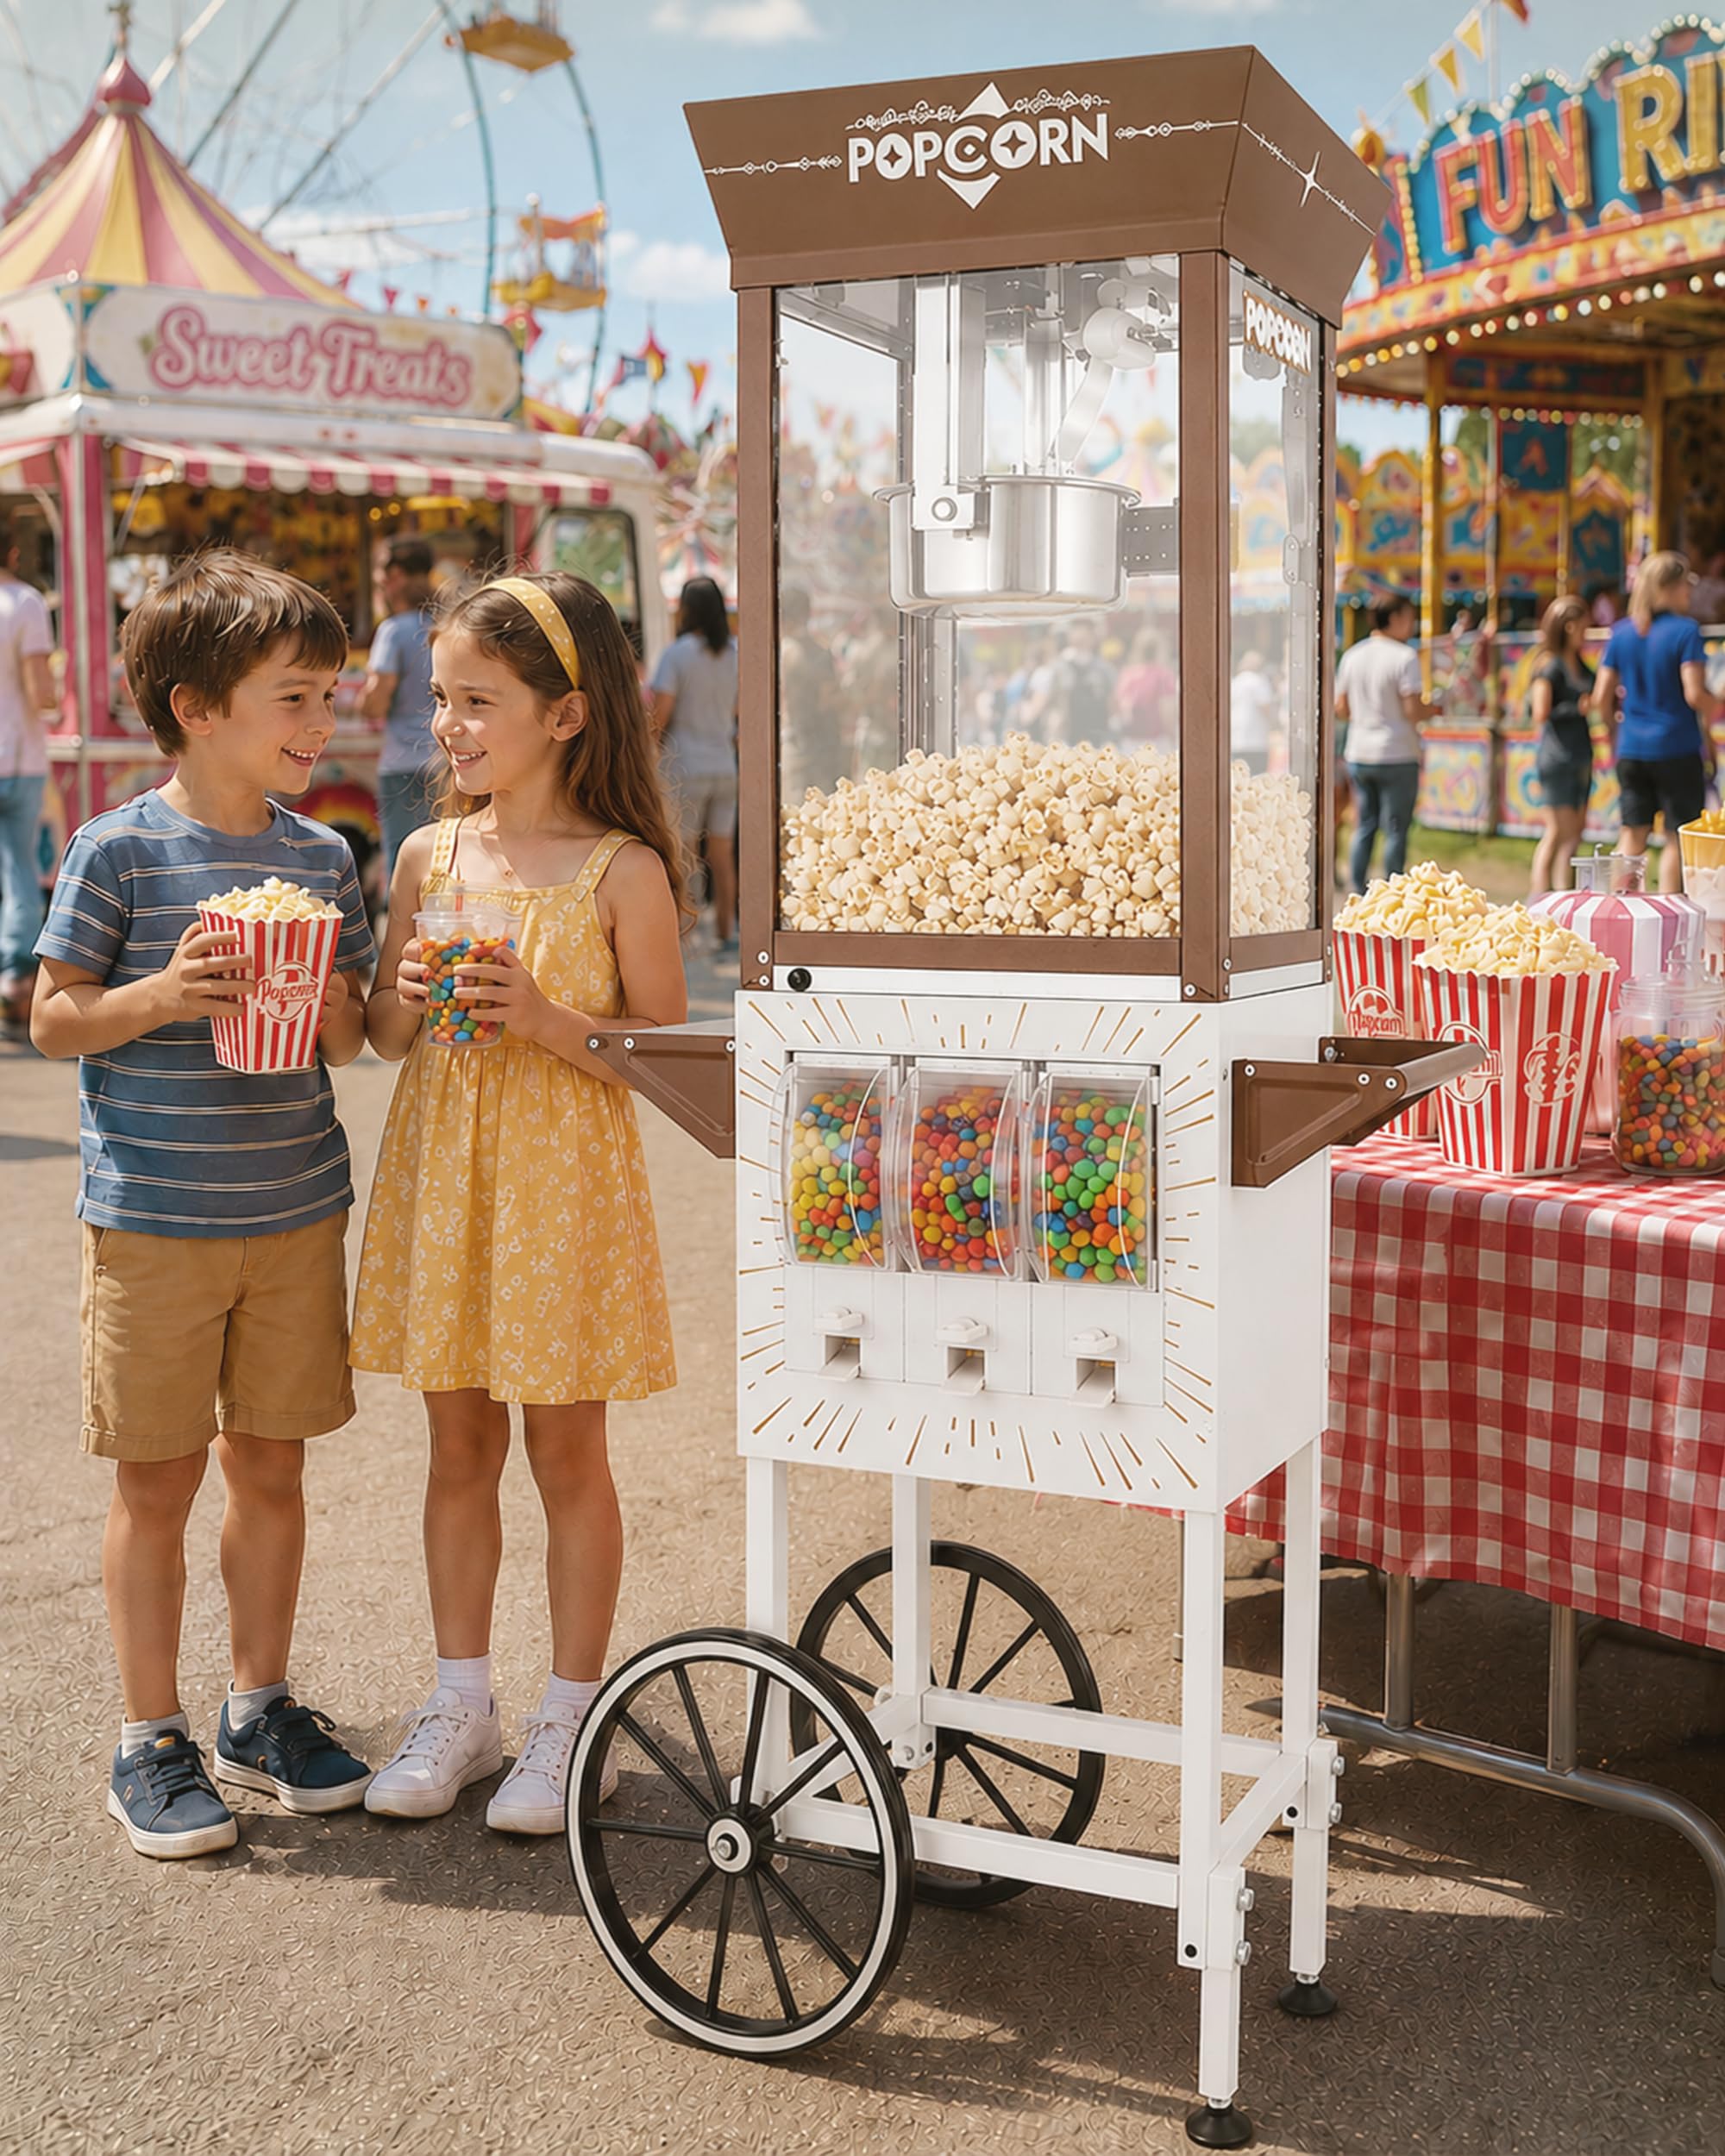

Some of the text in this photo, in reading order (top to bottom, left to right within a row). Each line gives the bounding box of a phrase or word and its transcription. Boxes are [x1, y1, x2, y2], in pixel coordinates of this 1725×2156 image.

[848, 113, 1109, 183] POPCORN
[1433, 49, 1725, 253] FUN RI
[149, 304, 473, 409] Sweet Treats
[1245, 297, 1312, 373] POPCORN
